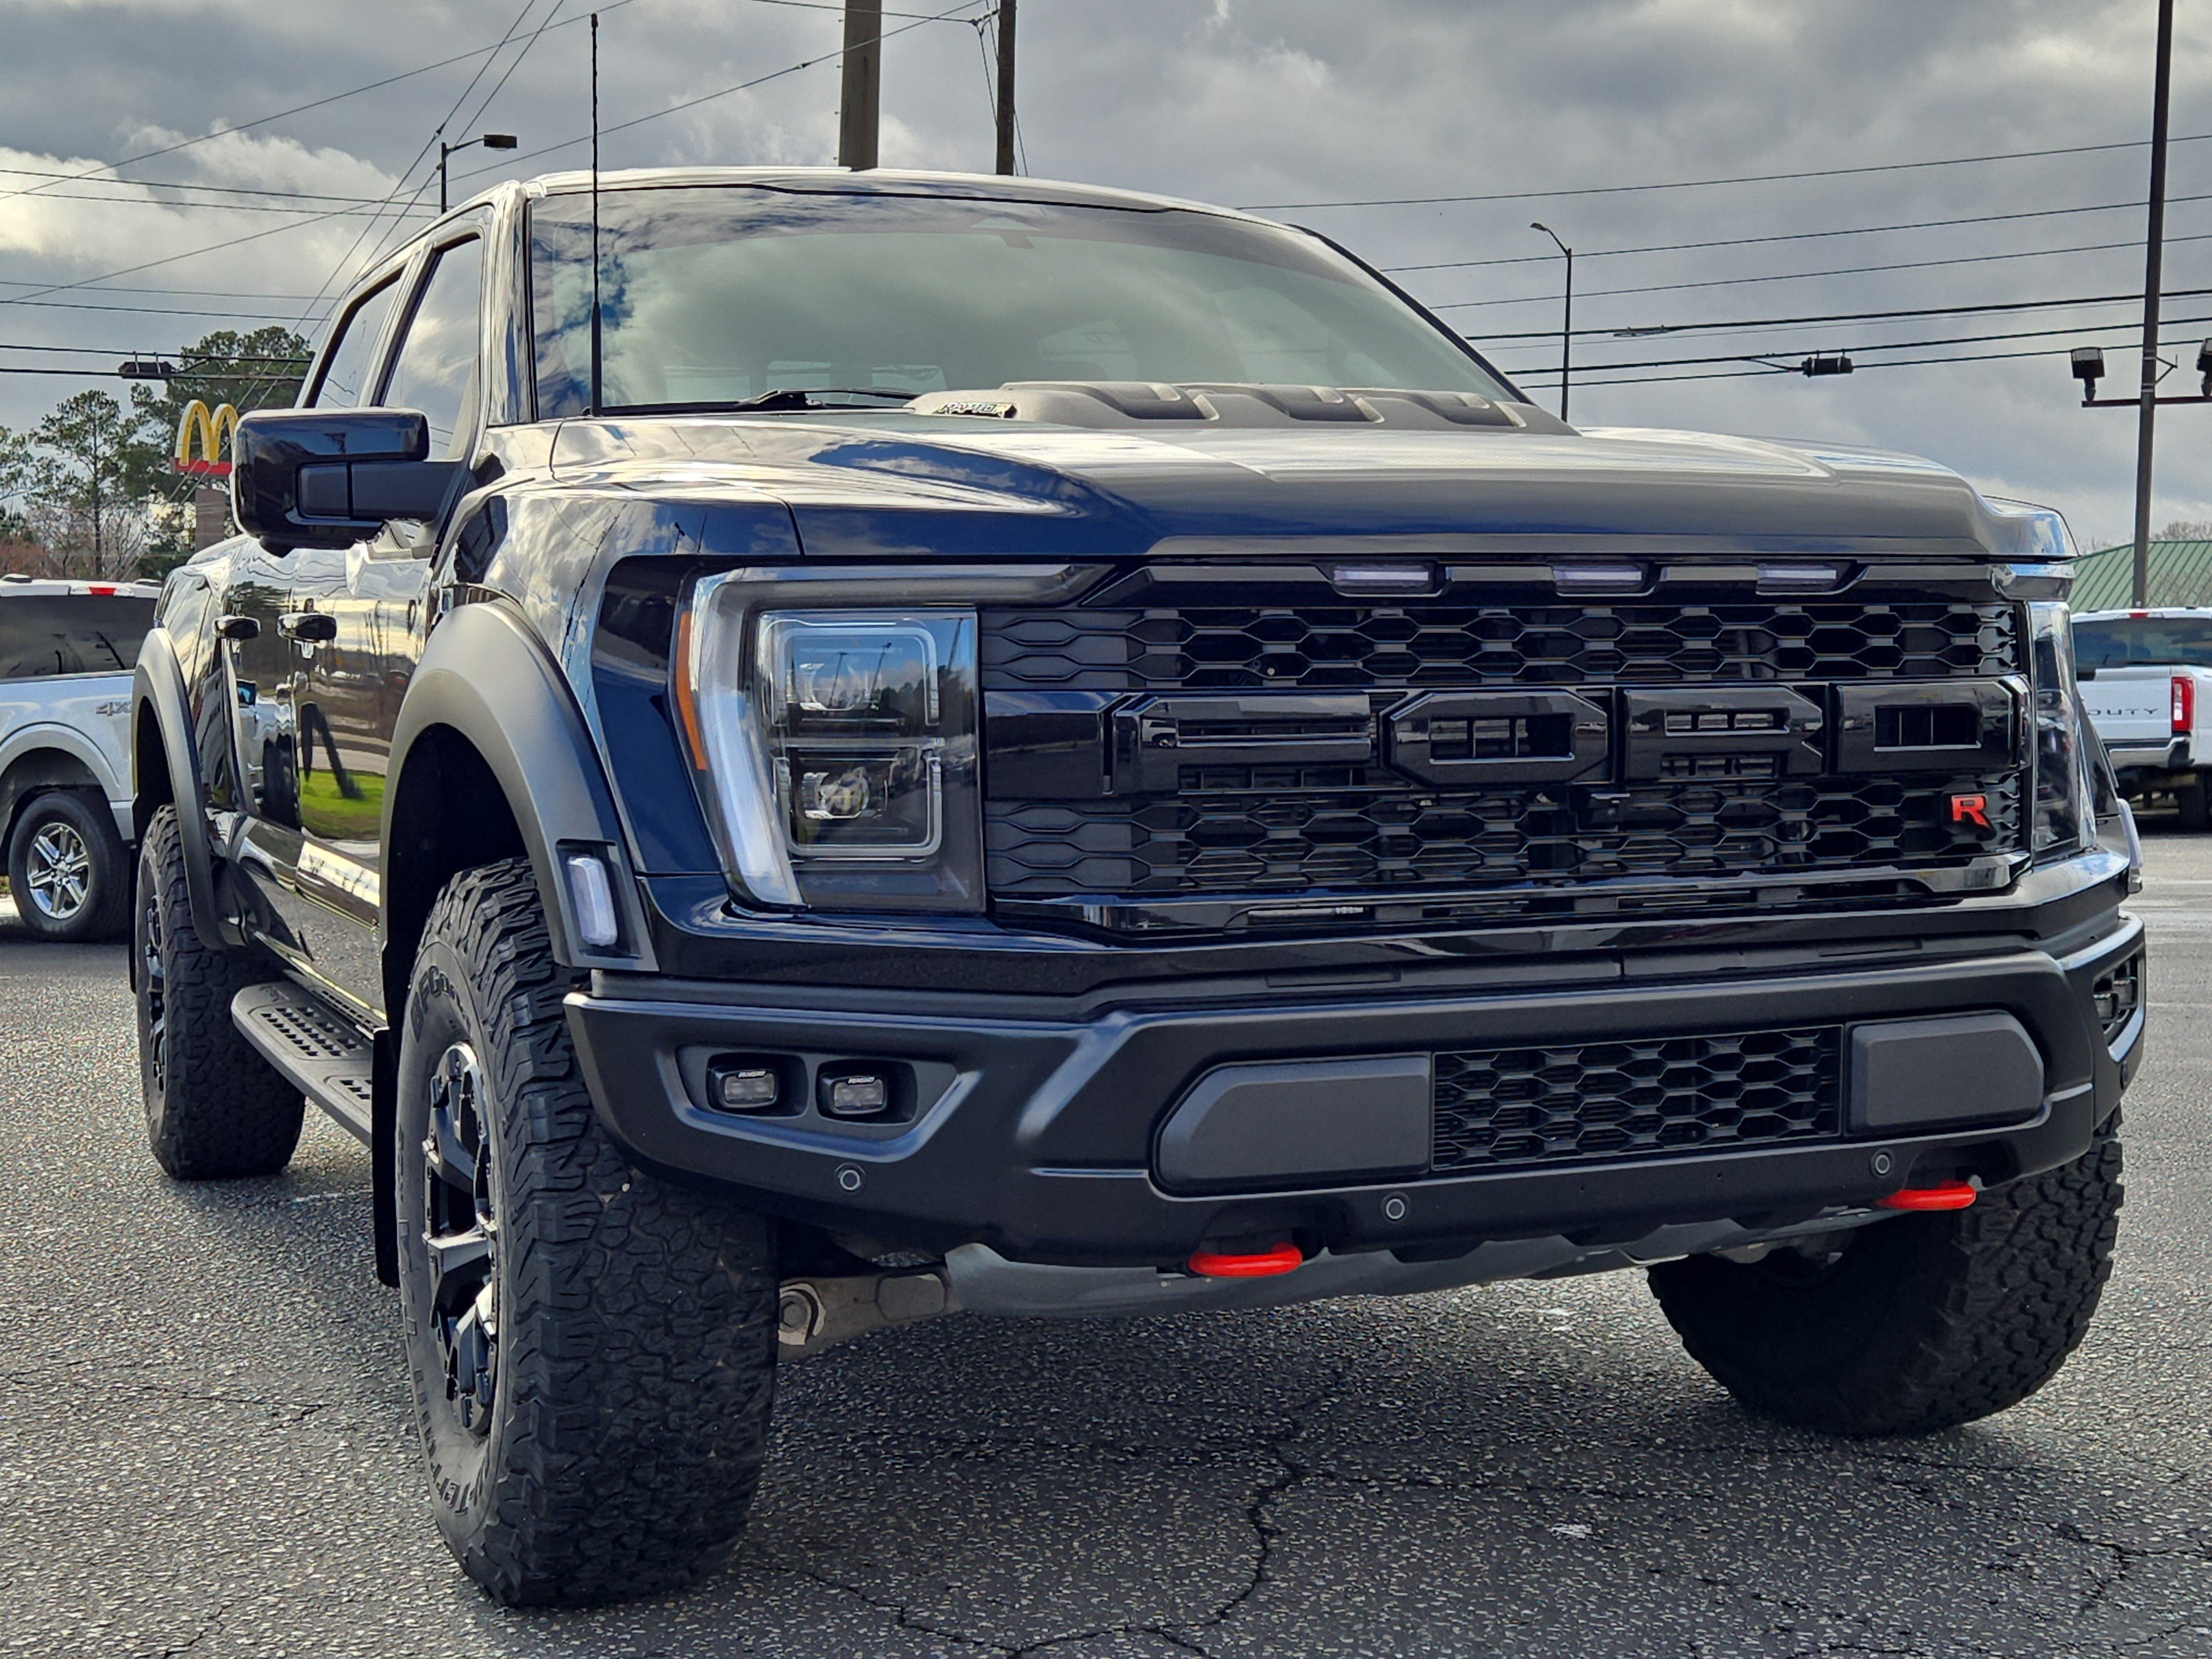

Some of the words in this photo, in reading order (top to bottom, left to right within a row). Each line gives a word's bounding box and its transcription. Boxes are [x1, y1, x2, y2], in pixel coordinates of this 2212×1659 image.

[938, 402, 1012, 419] RAPTOR
[2087, 708, 2158, 716] DUTY
[1113, 681, 2012, 796] FORD
[1951, 793, 1990, 828] R
